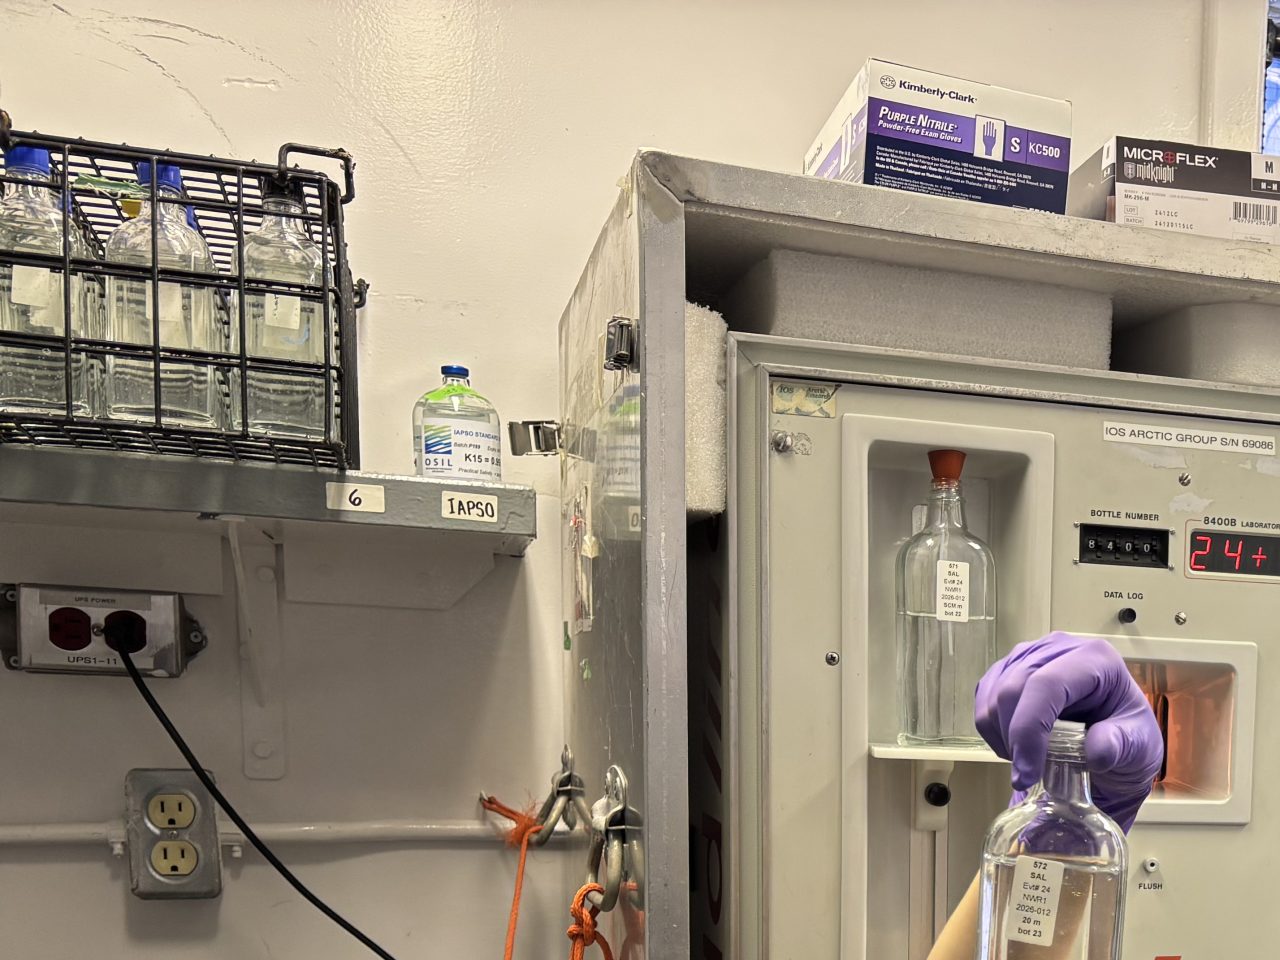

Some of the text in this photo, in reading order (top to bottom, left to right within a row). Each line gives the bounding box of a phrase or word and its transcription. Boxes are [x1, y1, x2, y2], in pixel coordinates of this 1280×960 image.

[899, 80, 975, 104] Kimberly-Clark
[878, 105, 917, 126] PURPLE
[917, 114, 955, 133] NITRILE
[877, 119, 920, 135] Powder-Free
[920, 128, 939, 140] Exam
[939, 131, 962, 144] Gloves
[1010, 137, 1021, 153] S
[1028, 141, 1061, 159] KC500
[1136, 161, 1175, 183] midknight
[1264, 160, 1274, 174] M
[453, 429, 474, 437] IAPSO
[1105, 426, 1274, 450] IOS ARCTIC GROUP S/N 69086
[424, 457, 453, 467] OSIL
[464, 453, 483, 464] K15
[348, 488, 363, 507] 6
[447, 497, 495, 518] IAPSO
[1090, 509, 1160, 522] BOTTLE NUMBER
[1203, 516, 1237, 527] 8400B
[1103, 591, 1144, 600] DATA LOG
[67, 655, 118, 665] UPS1-11
[1033, 861, 1048, 870] 572
[1030, 872, 1047, 881] SAL
[1041, 885, 1051, 893] 24
[1137, 882, 1163, 890] FLUSH
[1022, 893, 1047, 904] NWR1
[1022, 916, 1032, 925] 20
[1017, 927, 1042, 938] bot 23
